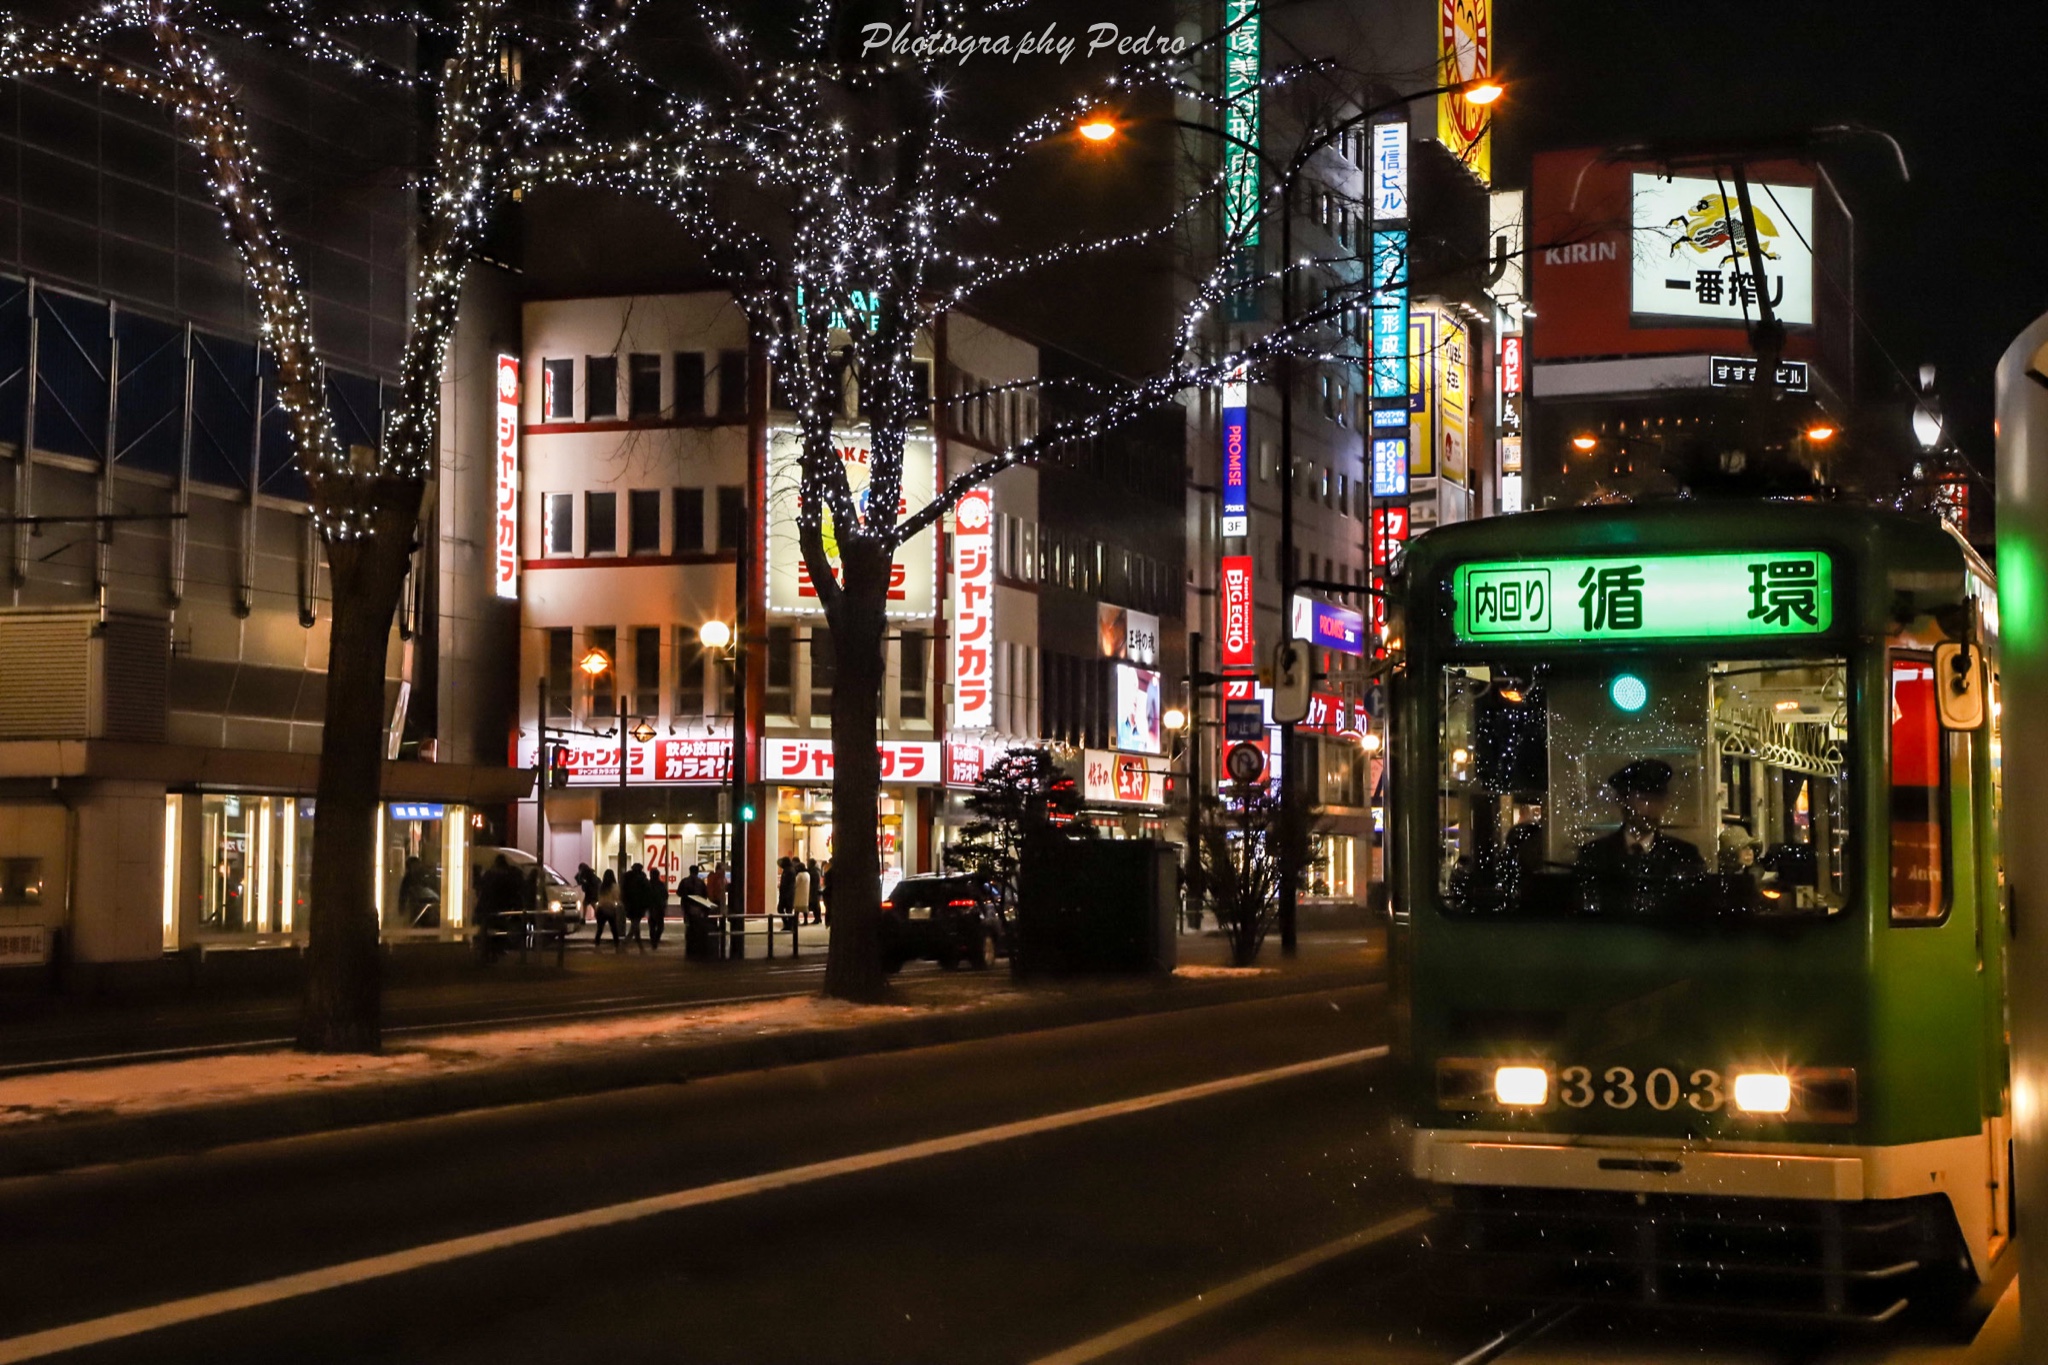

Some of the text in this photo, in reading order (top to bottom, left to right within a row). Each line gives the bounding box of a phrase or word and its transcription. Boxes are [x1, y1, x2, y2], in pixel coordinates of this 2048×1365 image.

[1381, 129, 1402, 209] 三信ビル
[1545, 241, 1617, 265] KIRIN
[1665, 269, 1784, 308] 一番搾り
[1229, 425, 1242, 486] PROMISE
[499, 417, 516, 582] ジャンカラ
[1228, 521, 1242, 532] 3F
[1226, 569, 1244, 653] BIG ECHO
[1474, 579, 1545, 624] 内回り
[957, 546, 987, 712] ジャンカラ
[665, 757, 733, 778] カラオケ
[1560, 1065, 1723, 1113] 3303
